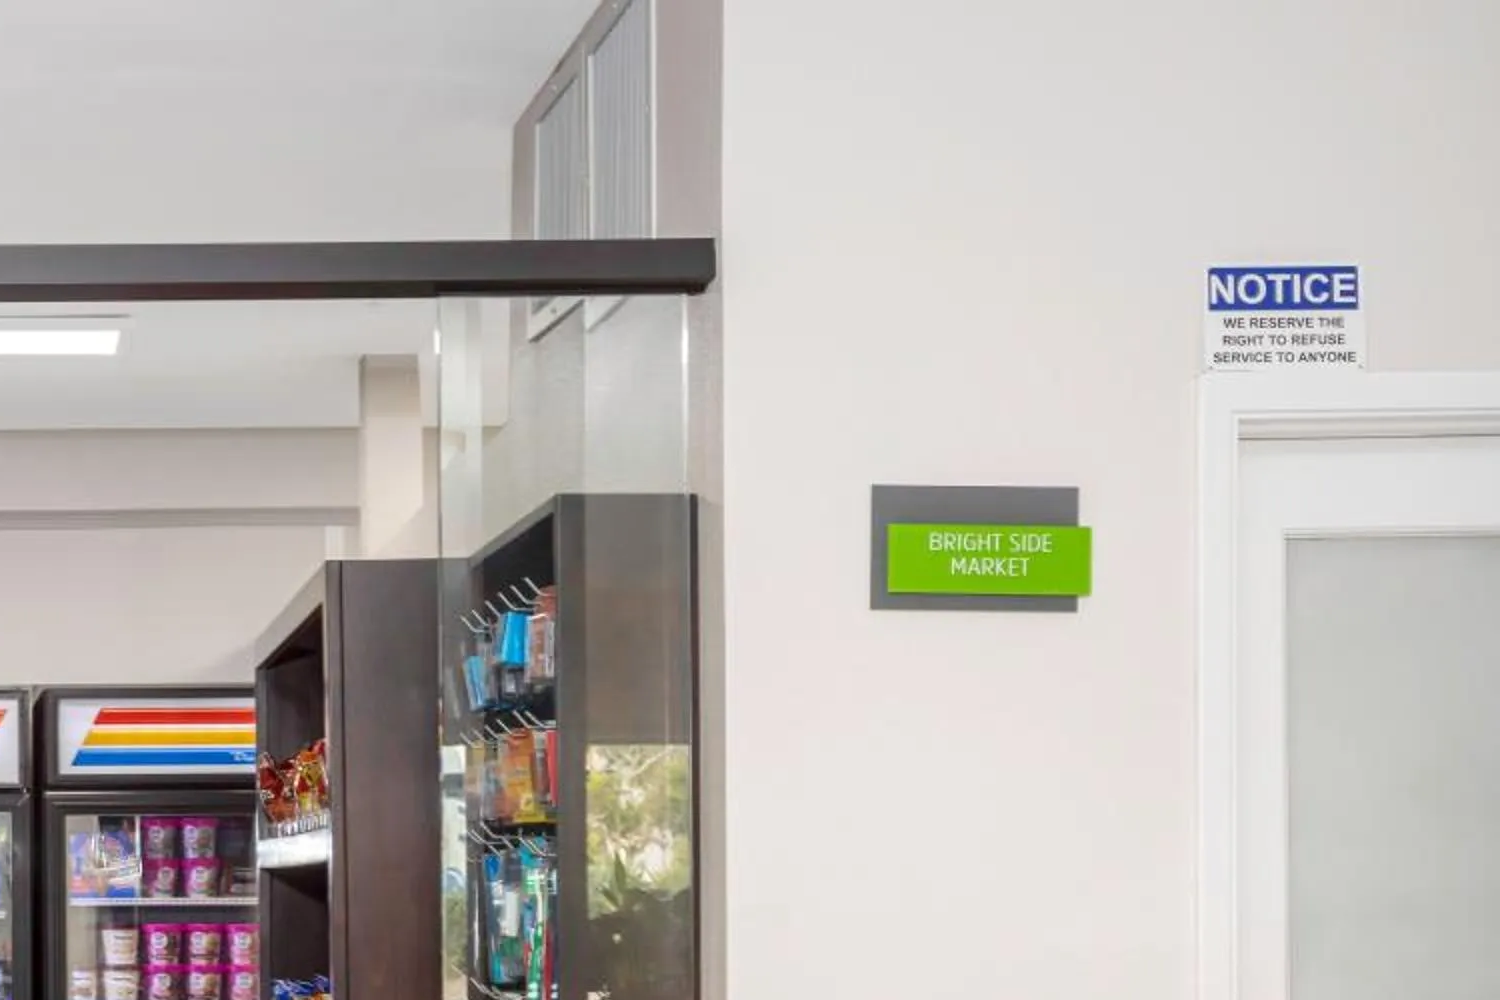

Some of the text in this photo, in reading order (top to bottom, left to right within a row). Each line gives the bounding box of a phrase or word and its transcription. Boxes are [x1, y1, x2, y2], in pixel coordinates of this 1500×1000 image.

[1210, 273, 1357, 305] NOTICE
[1223, 316, 1345, 329] WE RESERVE THE
[1222, 333, 1346, 346] RIGHT TO REFUSE
[1213, 351, 1357, 364] SERVICE TO ANYONE
[929, 531, 1053, 553] BRIGHT SIDE
[951, 557, 1030, 577] MARKET
